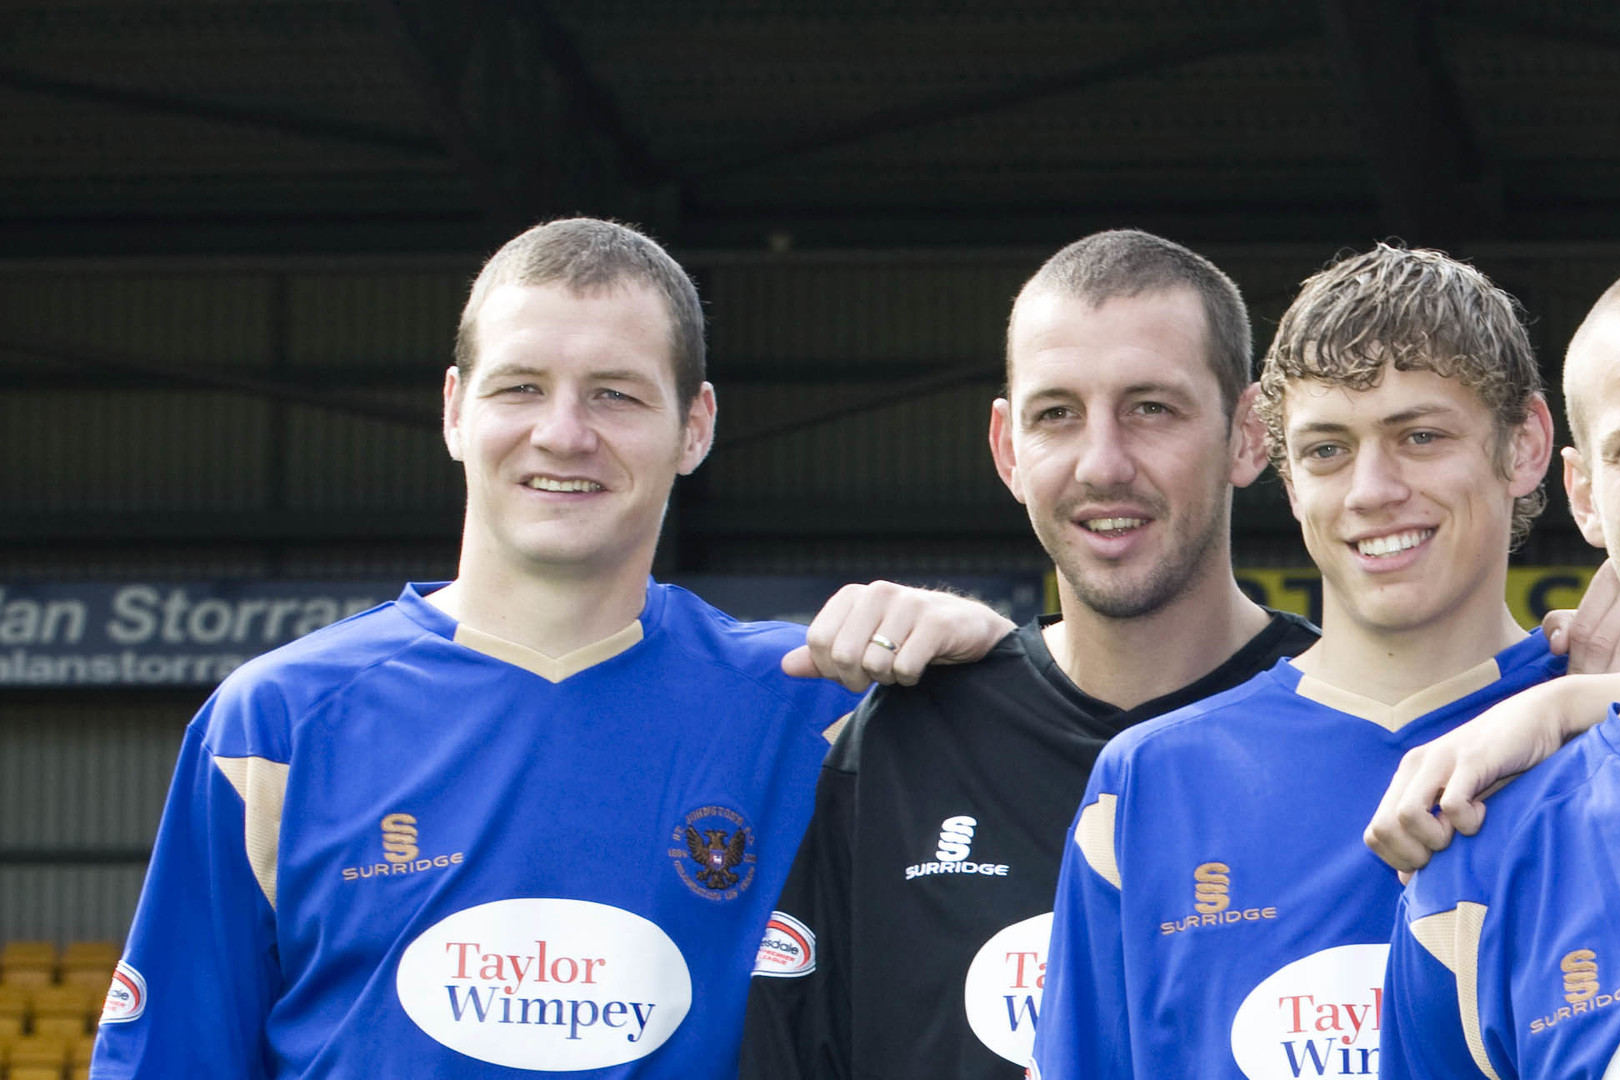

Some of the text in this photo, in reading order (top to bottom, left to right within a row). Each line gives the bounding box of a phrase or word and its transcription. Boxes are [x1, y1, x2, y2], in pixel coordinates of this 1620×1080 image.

[342, 852, 464, 880] SURRIDGE
[905, 861, 1010, 880] SURRIDGE
[1160, 907, 1278, 935] SURRIDGE
[446, 940, 606, 995] Taylor
[444, 985, 656, 1043] Wimpey
[1278, 988, 1383, 1045] Tayl
